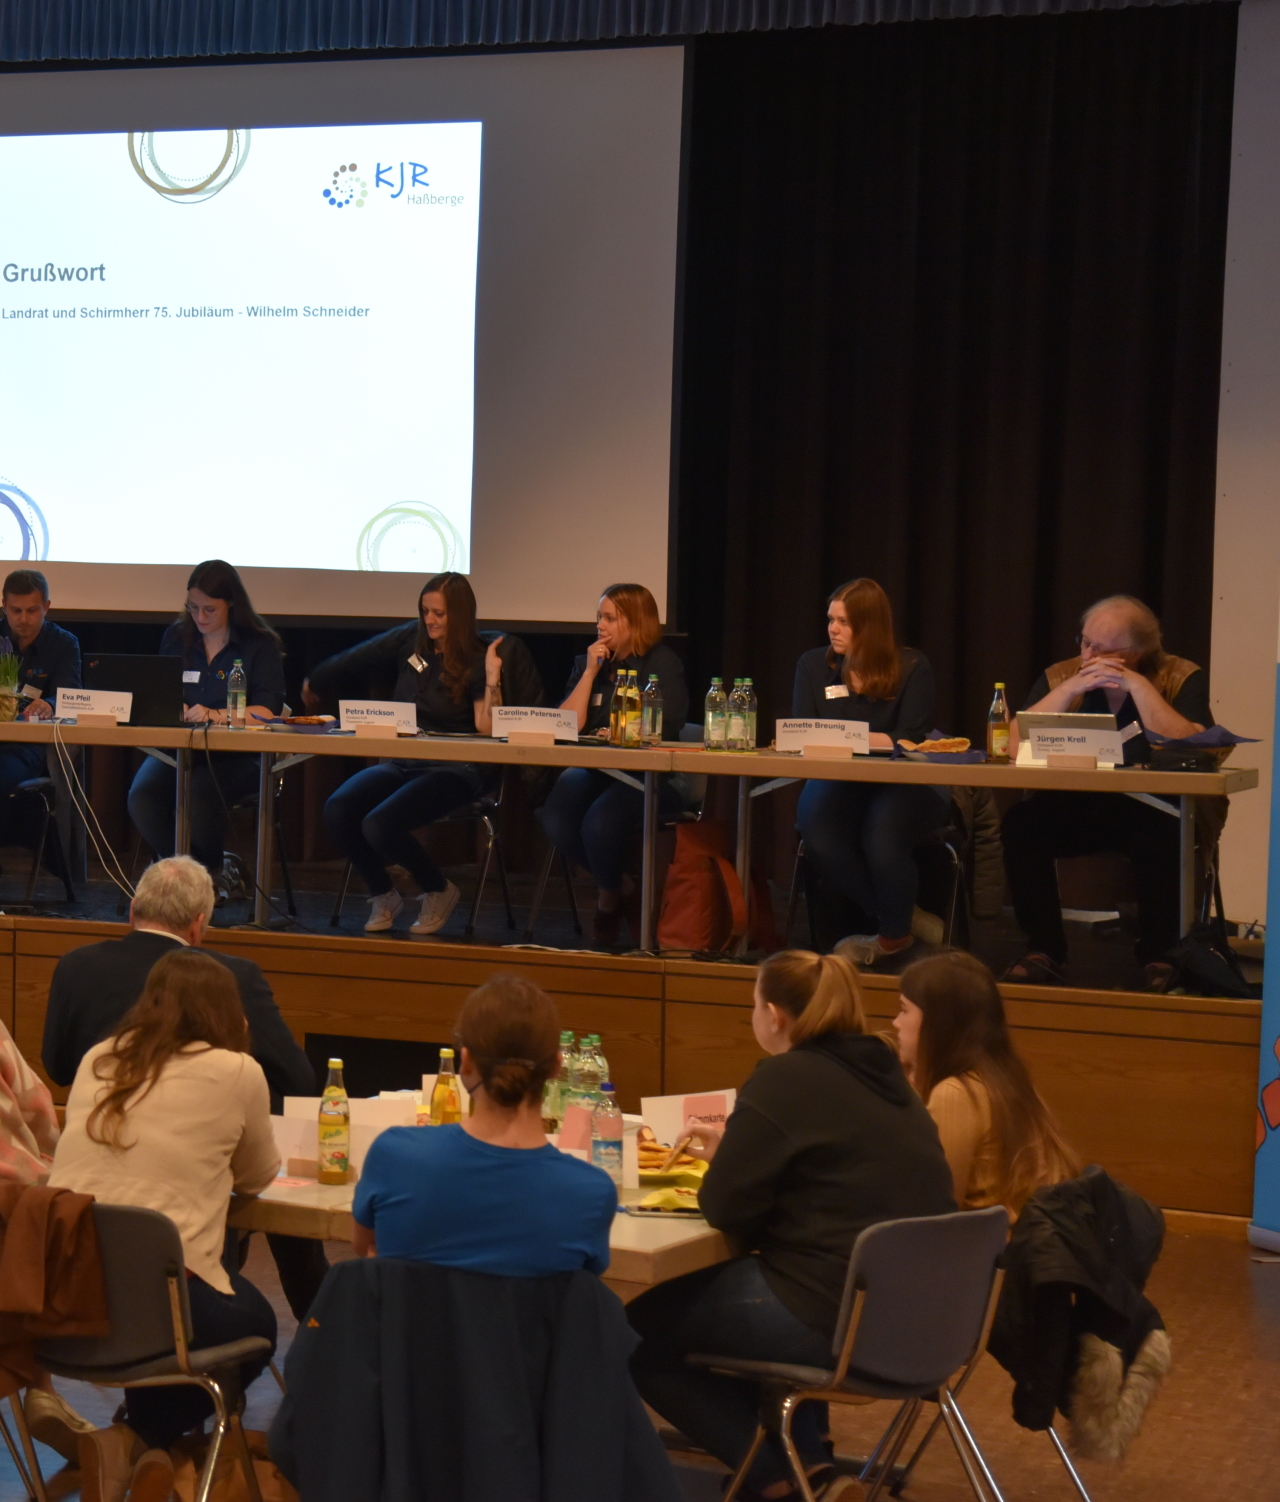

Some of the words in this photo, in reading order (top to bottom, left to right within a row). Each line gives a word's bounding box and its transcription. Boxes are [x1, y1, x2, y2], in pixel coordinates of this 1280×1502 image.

[375, 162, 429, 198] KJR
[407, 193, 464, 207] Haßberge
[3, 262, 106, 282] Grußwort
[2, 307, 49, 319] Landrat
[52, 307, 76, 319] und
[80, 307, 150, 319] Schirmherr
[154, 306, 172, 318] 75.
[176, 306, 234, 318] Jubiläum
[246, 305, 298, 317] Wilhelm
[302, 305, 370, 317] Schneider
[76, 694, 91, 702] Pfeil
[366, 709, 395, 717] Erickson
[530, 710, 562, 718] Petersen
[814, 722, 846, 731] Breunig
[1036, 735, 1065, 743] Jürgen
[1067, 735, 1086, 743] Krell
